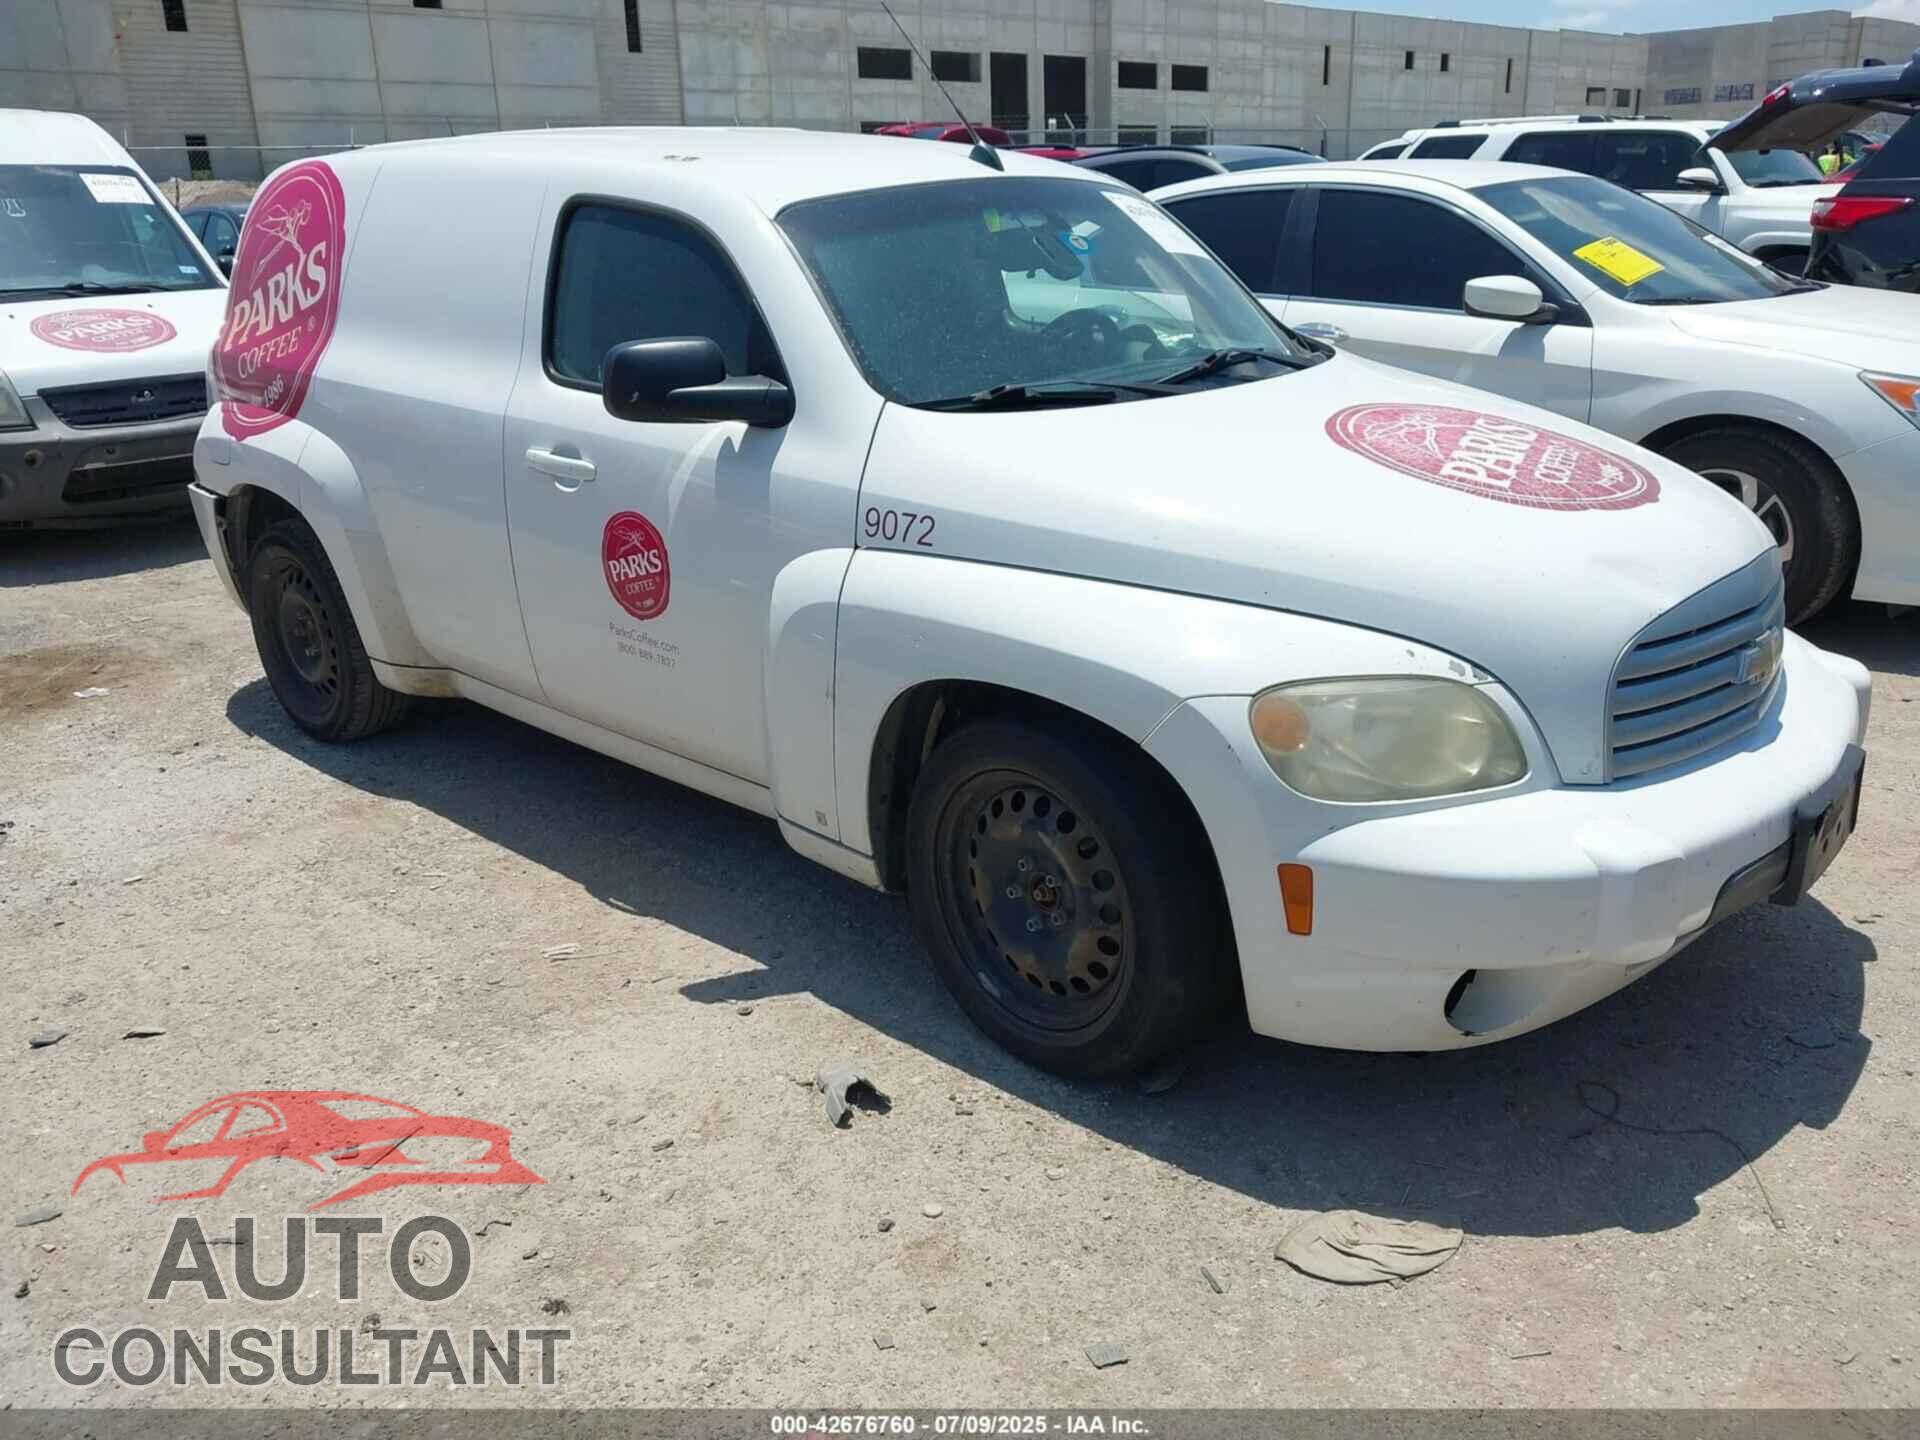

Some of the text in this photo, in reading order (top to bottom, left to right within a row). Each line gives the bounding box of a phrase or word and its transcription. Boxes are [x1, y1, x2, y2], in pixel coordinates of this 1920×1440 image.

[224, 241, 326, 352] PARKS
[50, 315, 152, 341] PARKS
[238, 325, 302, 378] COFFEE
[264, 373, 285, 408] 1986
[1439, 417, 1538, 488] PARKS
[1534, 440, 1579, 484] COFFEE
[865, 507, 935, 547] 9072
[608, 549, 662, 583] PARKS
[625, 579, 656, 595] COFFEE
